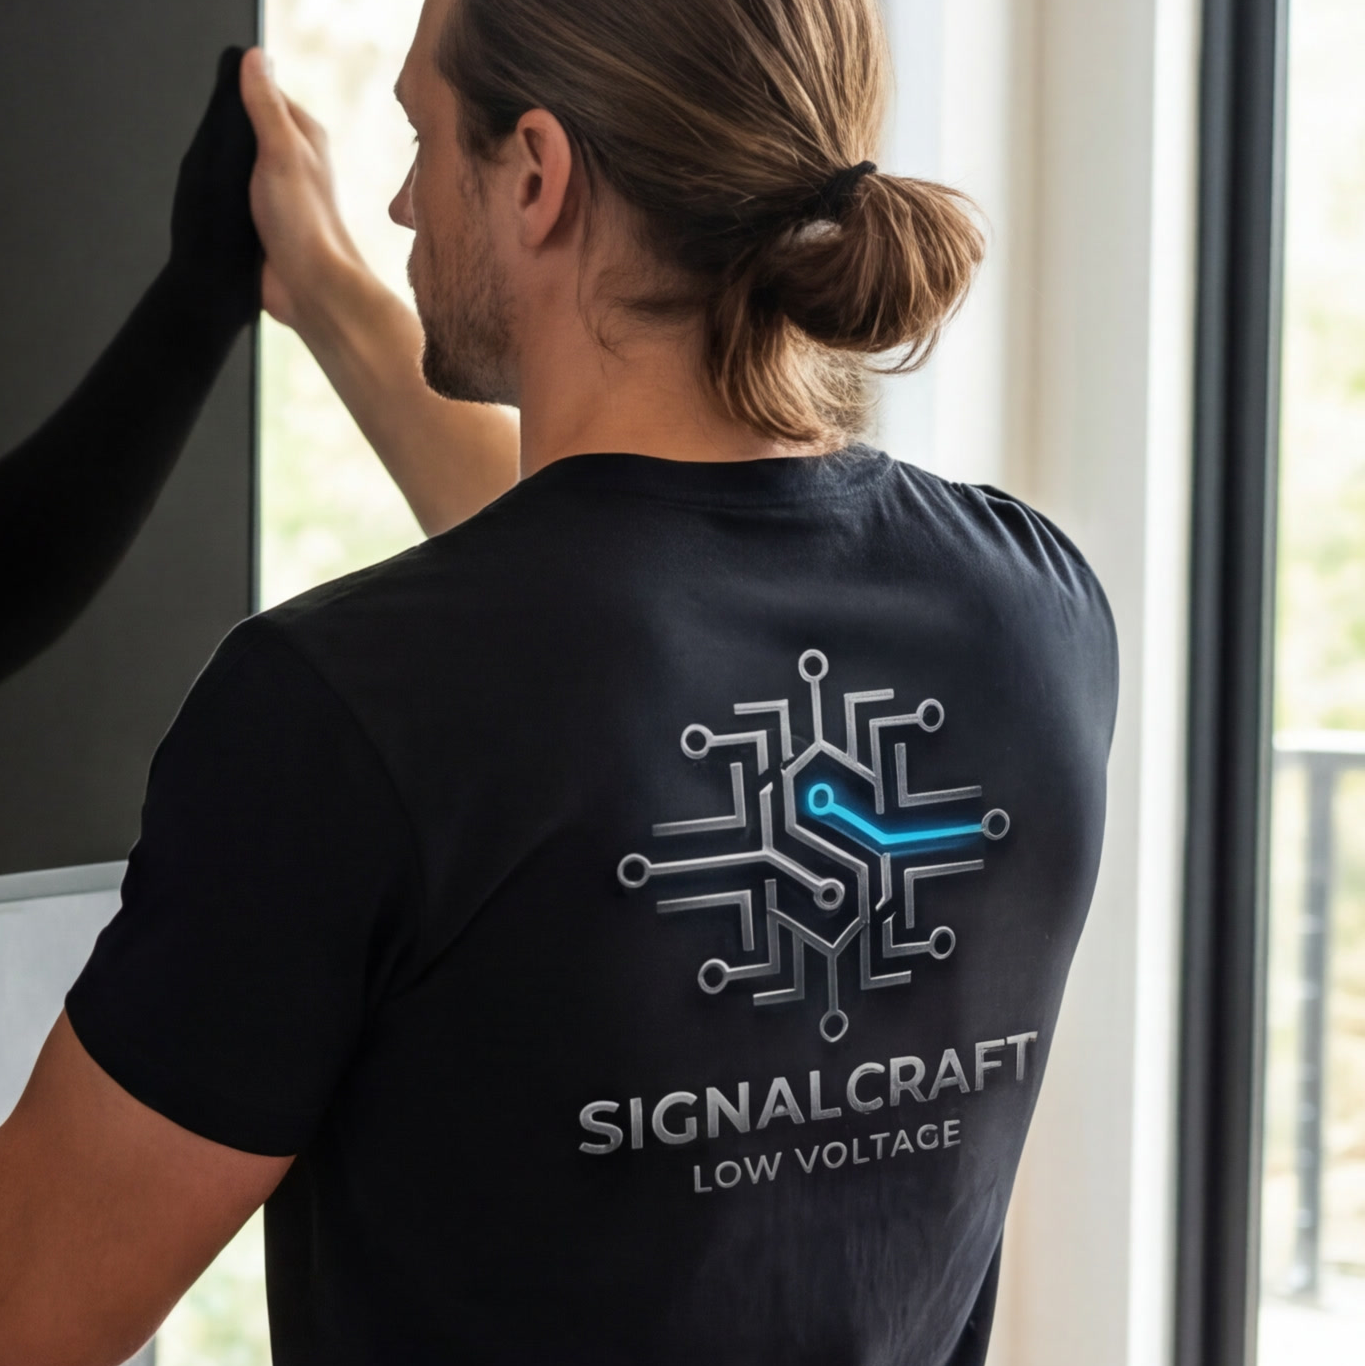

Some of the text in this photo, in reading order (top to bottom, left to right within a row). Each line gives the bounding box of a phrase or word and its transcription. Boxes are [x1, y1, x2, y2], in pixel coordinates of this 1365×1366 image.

[578, 1031, 1038, 1155] SIGNALCRAFT
[693, 1119, 962, 1193] LOW VOLTAGE
